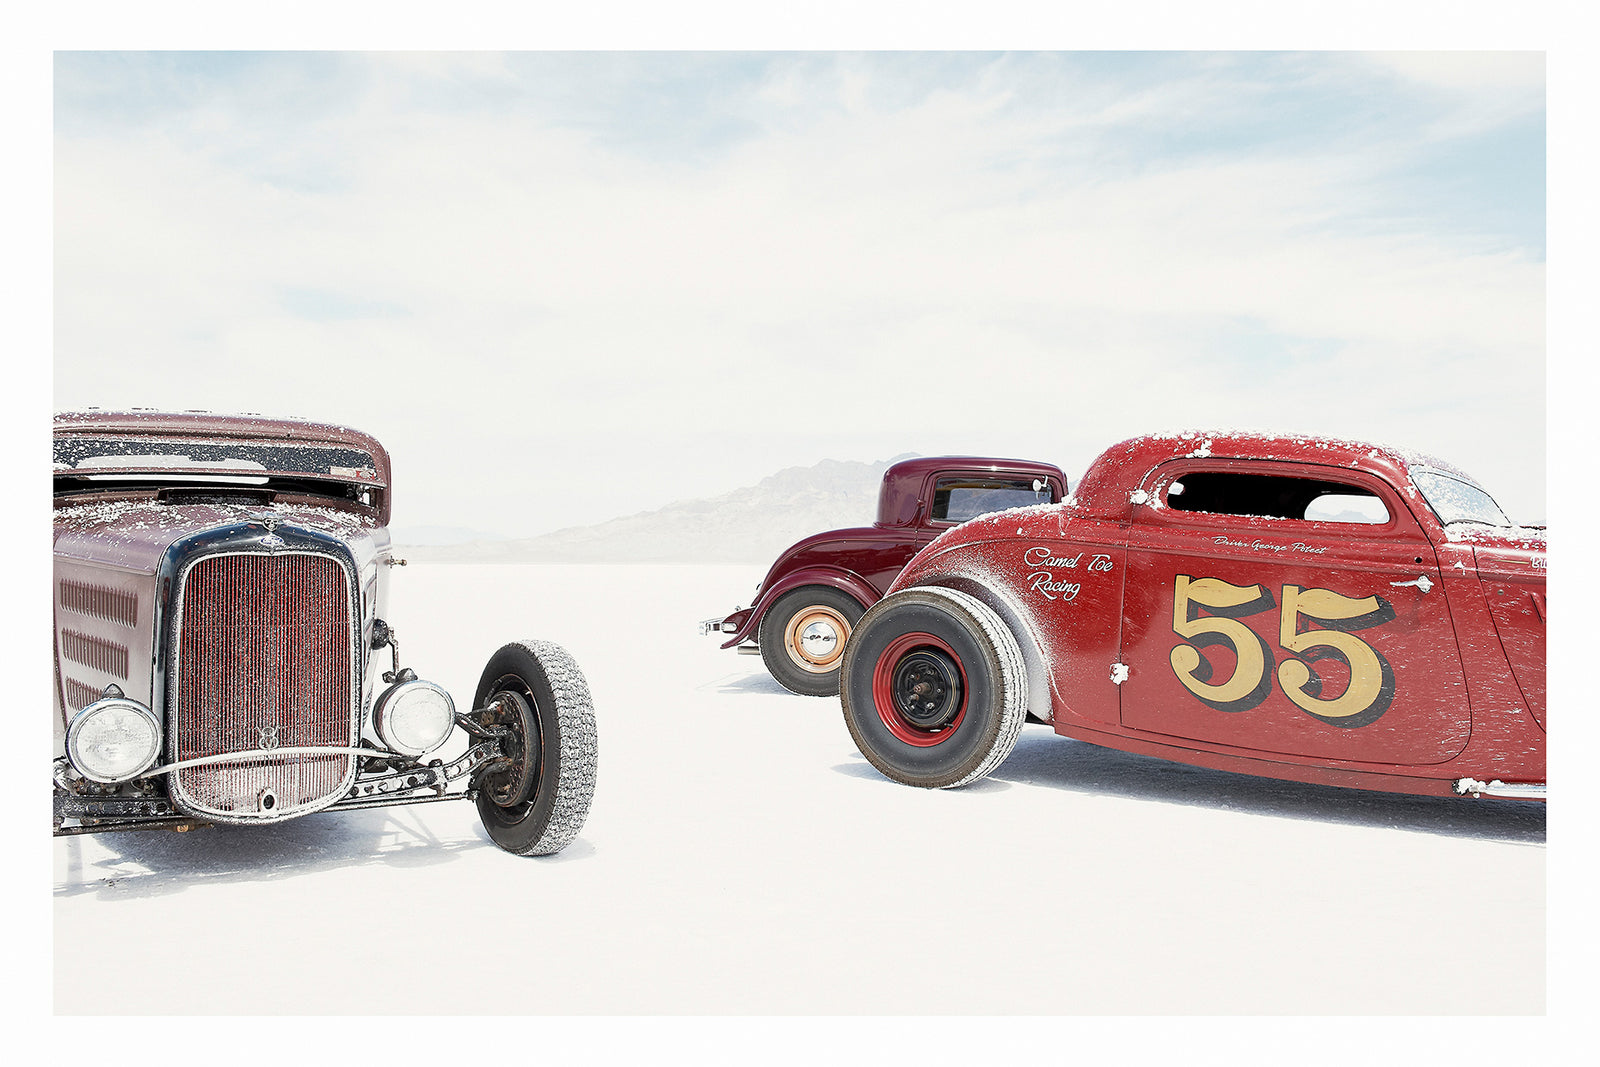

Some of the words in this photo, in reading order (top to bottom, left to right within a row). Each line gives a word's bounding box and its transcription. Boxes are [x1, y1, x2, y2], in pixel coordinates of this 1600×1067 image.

[1024, 546, 1084, 569] Camel
[1087, 554, 1113, 572] Toe
[1251, 539, 1287, 552] George
[1026, 571, 1081, 601] Racing
[1169, 574, 1397, 729] 55
